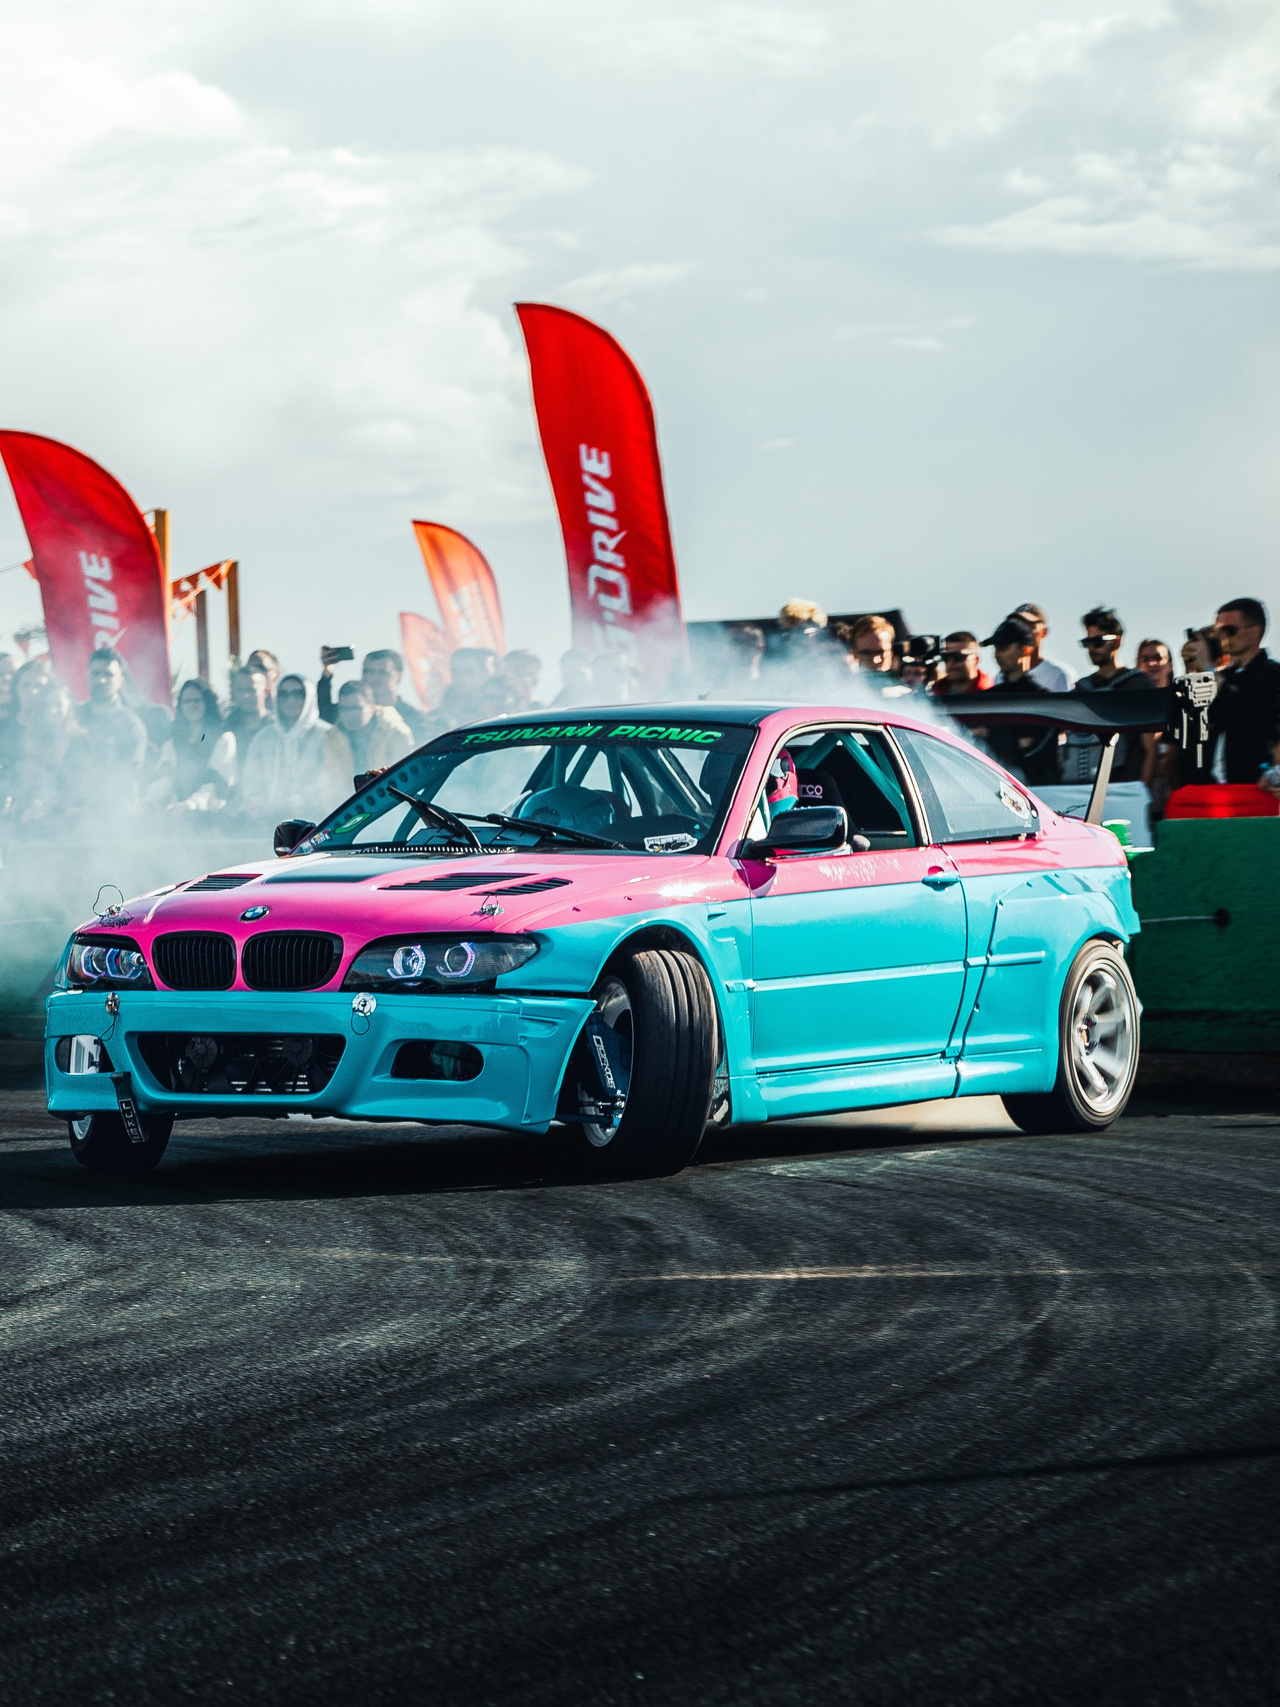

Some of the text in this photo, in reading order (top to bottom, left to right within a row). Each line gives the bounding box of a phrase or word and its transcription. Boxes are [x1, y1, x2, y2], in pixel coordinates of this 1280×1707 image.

[79, 550, 128, 650] RIVE
[460, 725, 723, 745] TSUNAMI PICNIC
[799, 784, 823, 797] rco
